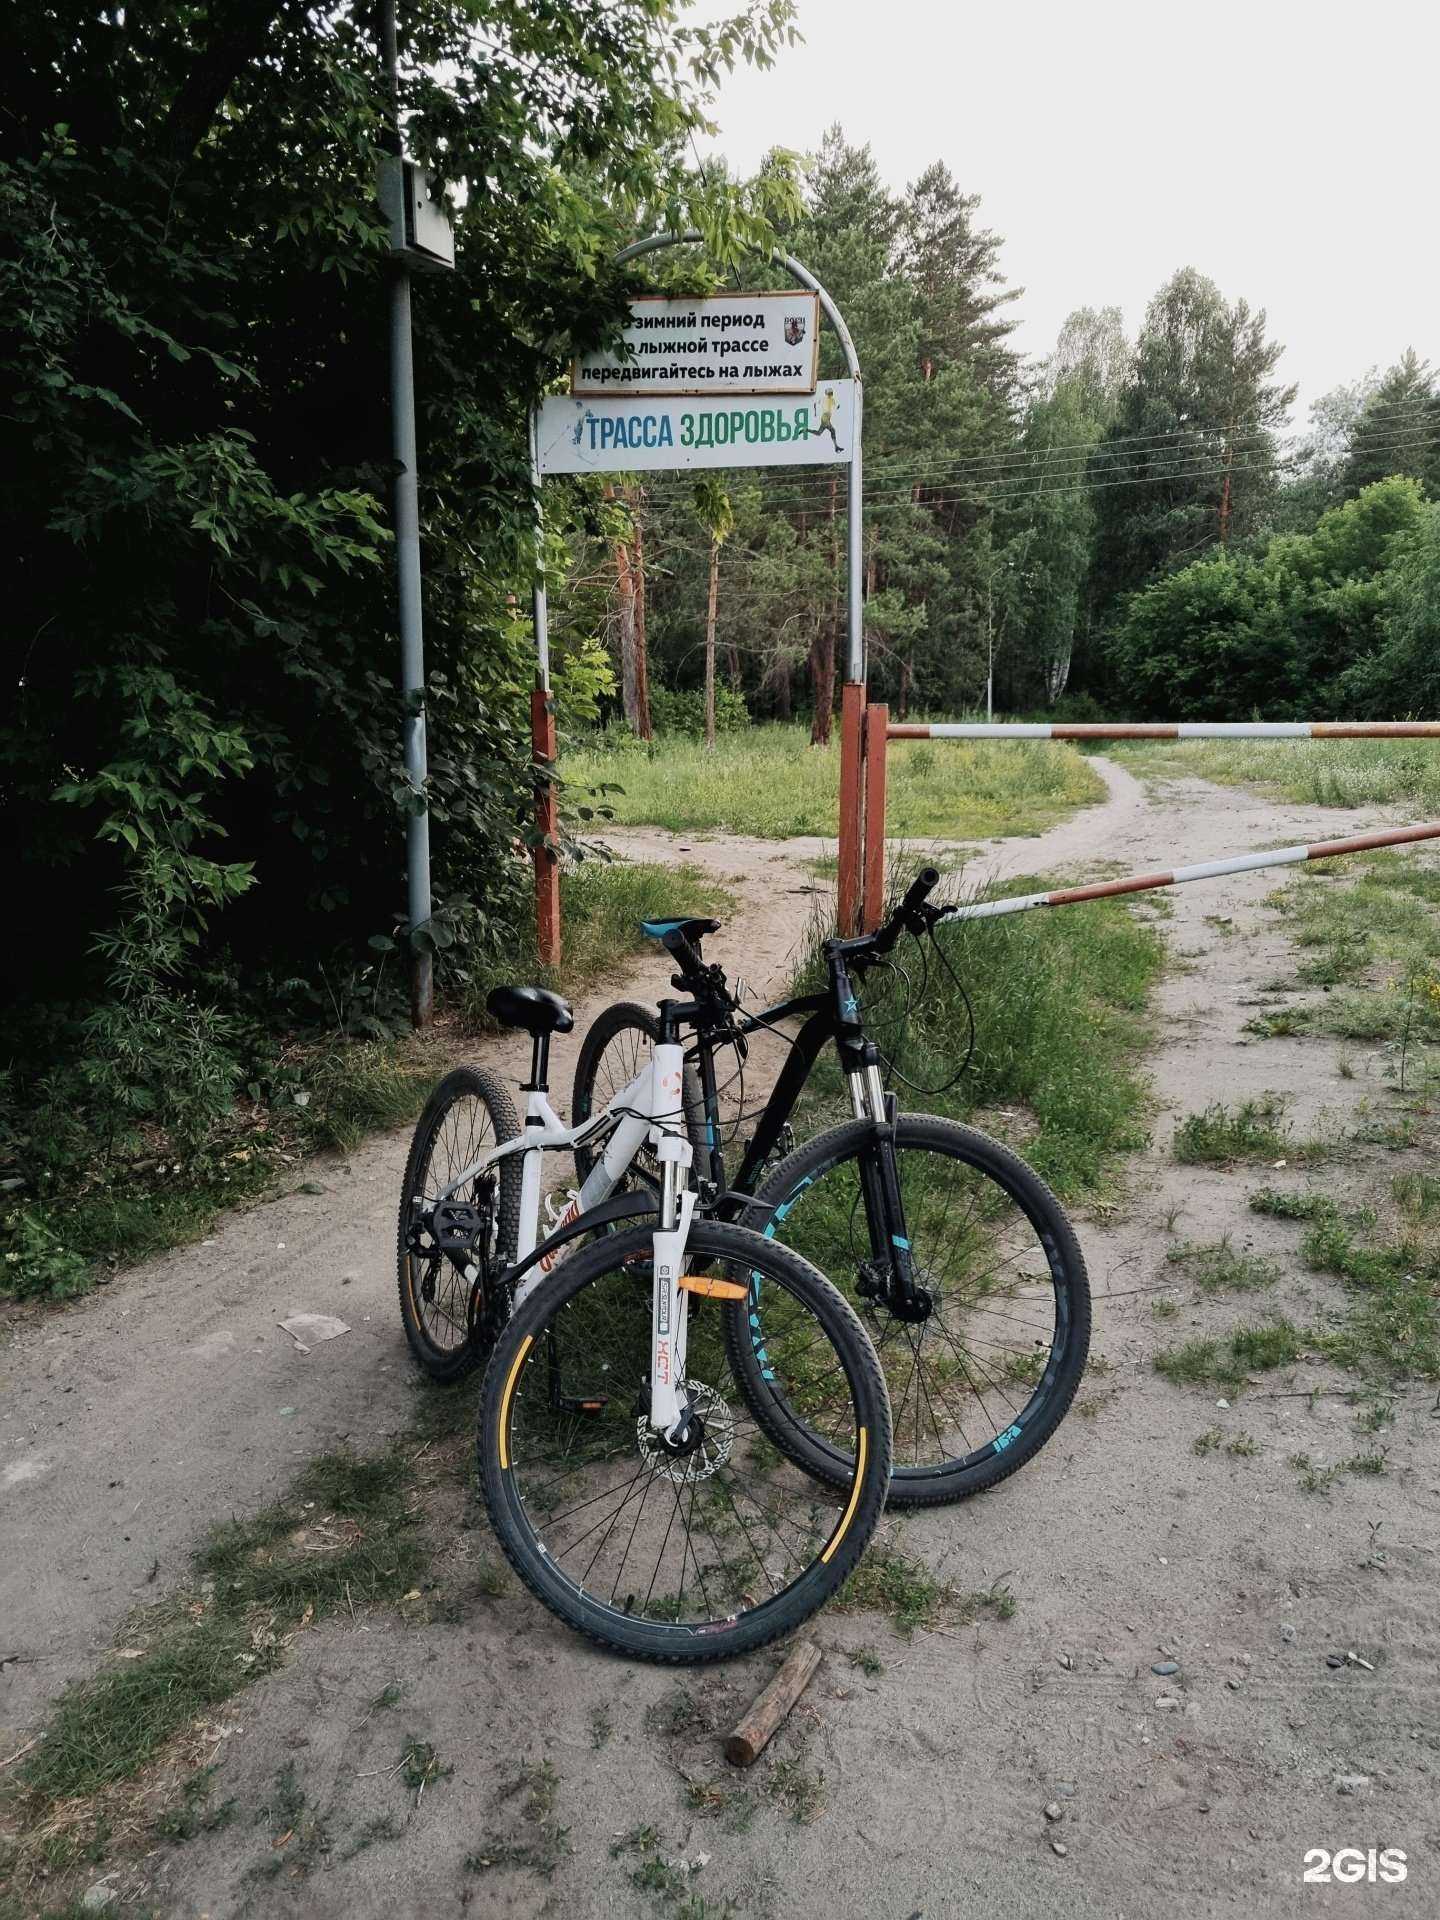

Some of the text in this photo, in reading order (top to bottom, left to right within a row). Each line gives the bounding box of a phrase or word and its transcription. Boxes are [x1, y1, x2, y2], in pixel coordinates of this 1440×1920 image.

[635, 311, 697, 329] зимний
[700, 312, 765, 332] период
[639, 337, 707, 354] лыжной
[711, 340, 769, 356] трассе
[581, 363, 802, 383] передвигайтесь на лыжах
[586, 407, 809, 449] ТРАССА ЗДОРОВЬЯ
[657, 1340, 669, 1385] XCT
